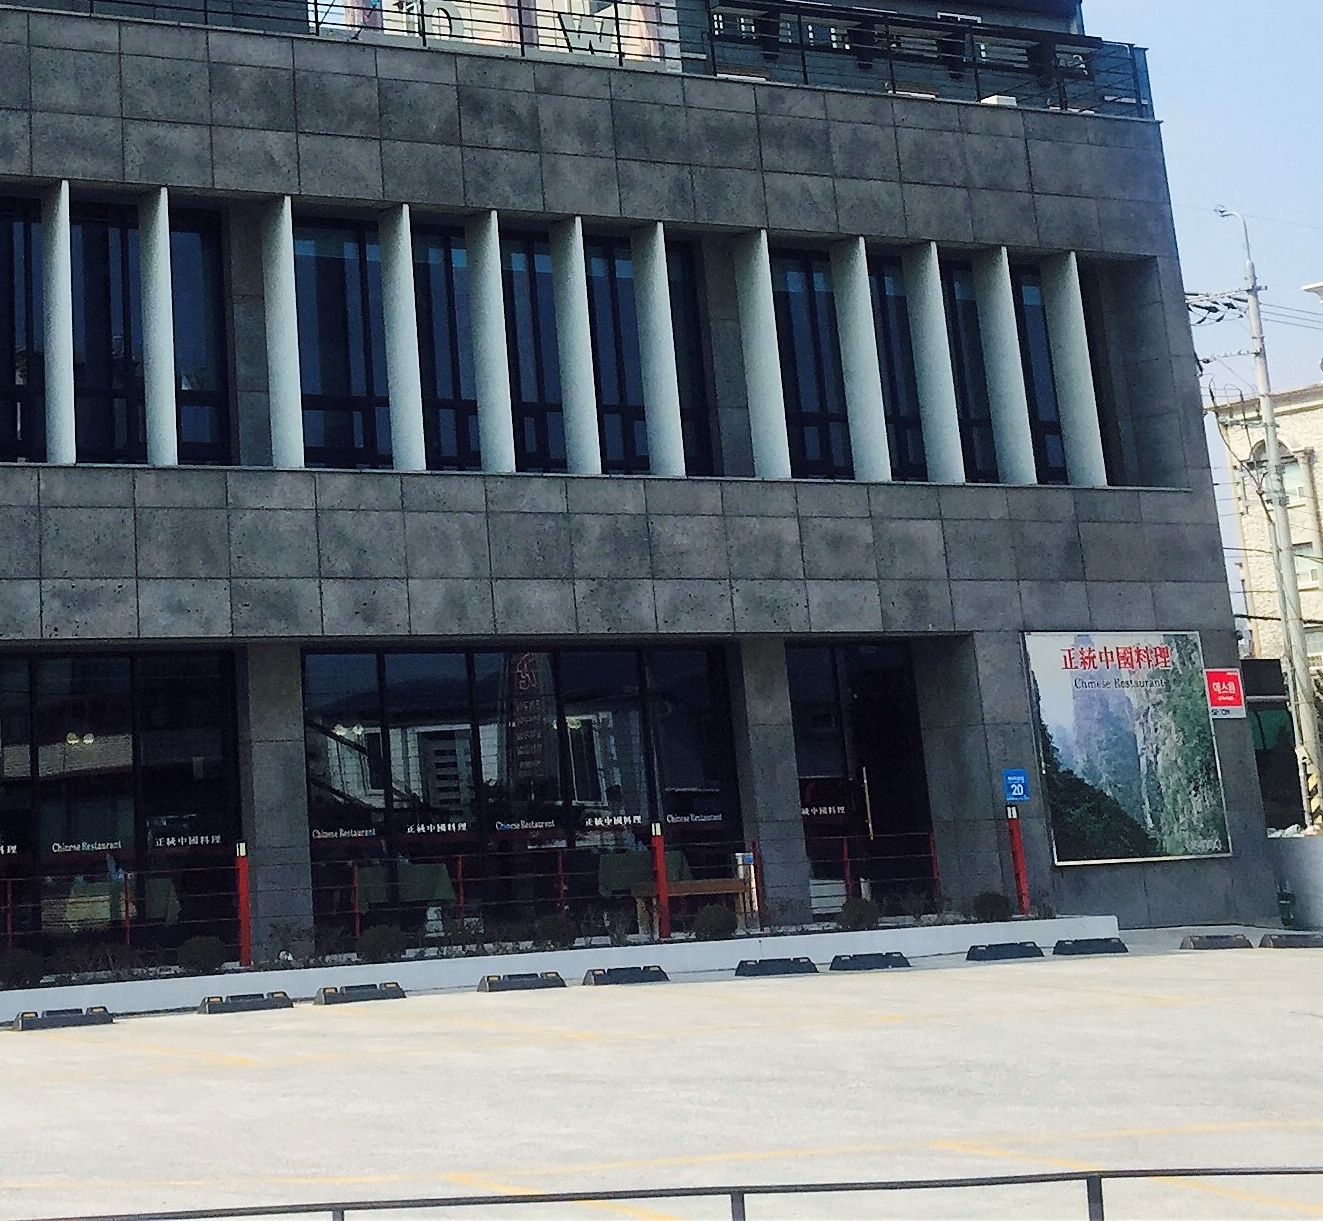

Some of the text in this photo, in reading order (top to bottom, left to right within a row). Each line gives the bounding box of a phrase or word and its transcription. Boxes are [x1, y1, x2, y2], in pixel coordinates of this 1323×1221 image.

[1060, 646, 1172, 670] 正統中國料理
[1010, 783, 1024, 796] 20
